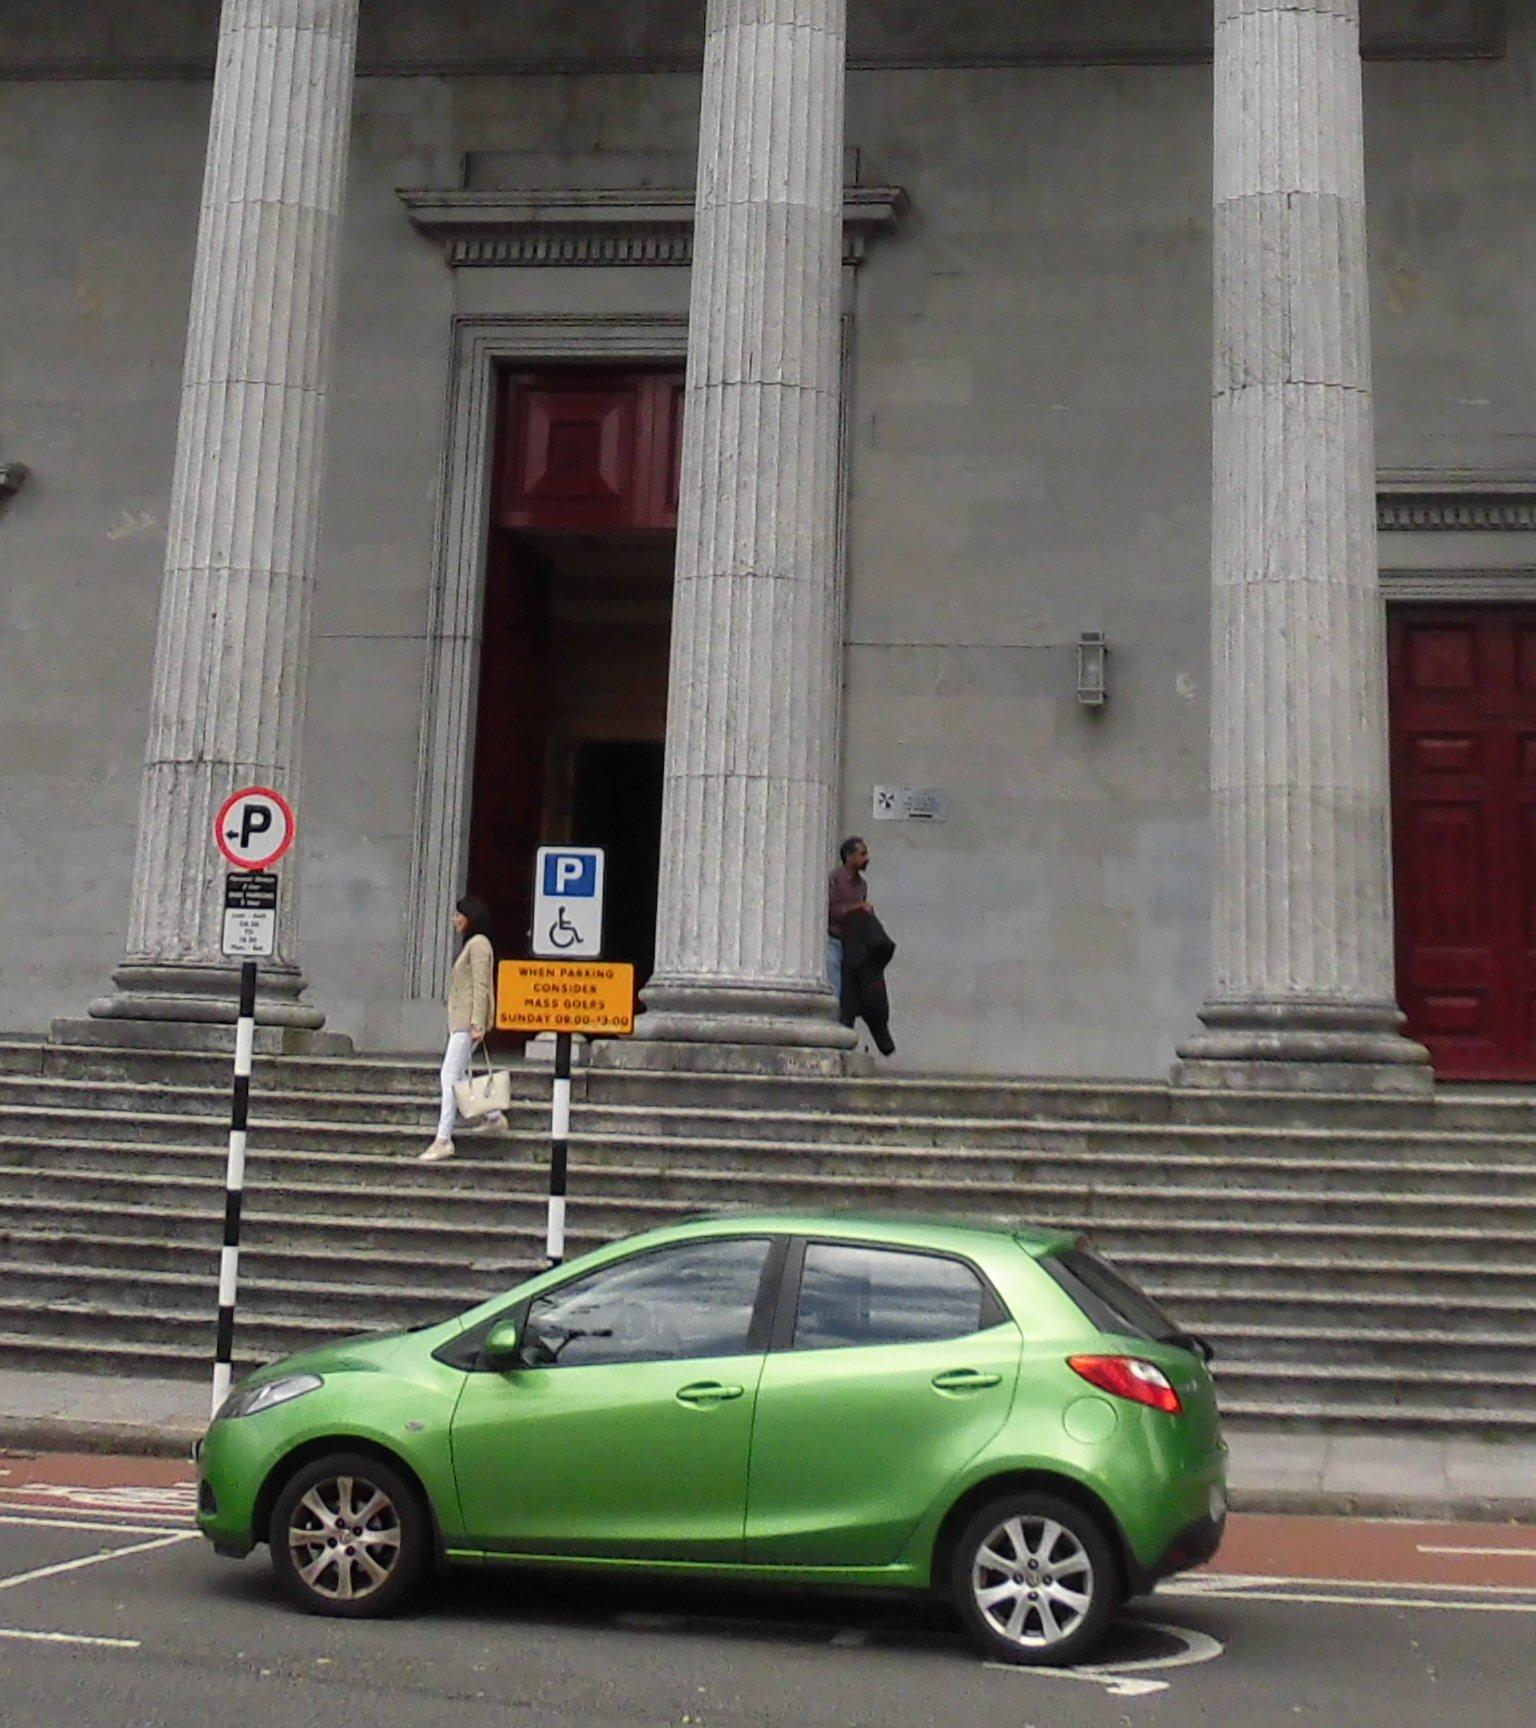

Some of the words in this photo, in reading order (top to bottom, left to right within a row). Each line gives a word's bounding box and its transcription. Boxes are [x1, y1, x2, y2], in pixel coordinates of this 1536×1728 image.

[240, 804, 272, 848] P
[556, 857, 584, 893] P
[519, 967, 555, 977] WHEN
[560, 968, 614, 979] PARKING
[533, 983, 597, 994] CONSIDER
[524, 998, 559, 1009] MASS
[563, 998, 606, 1010] GOERS
[500, 1013, 550, 1024] SUNDAY
